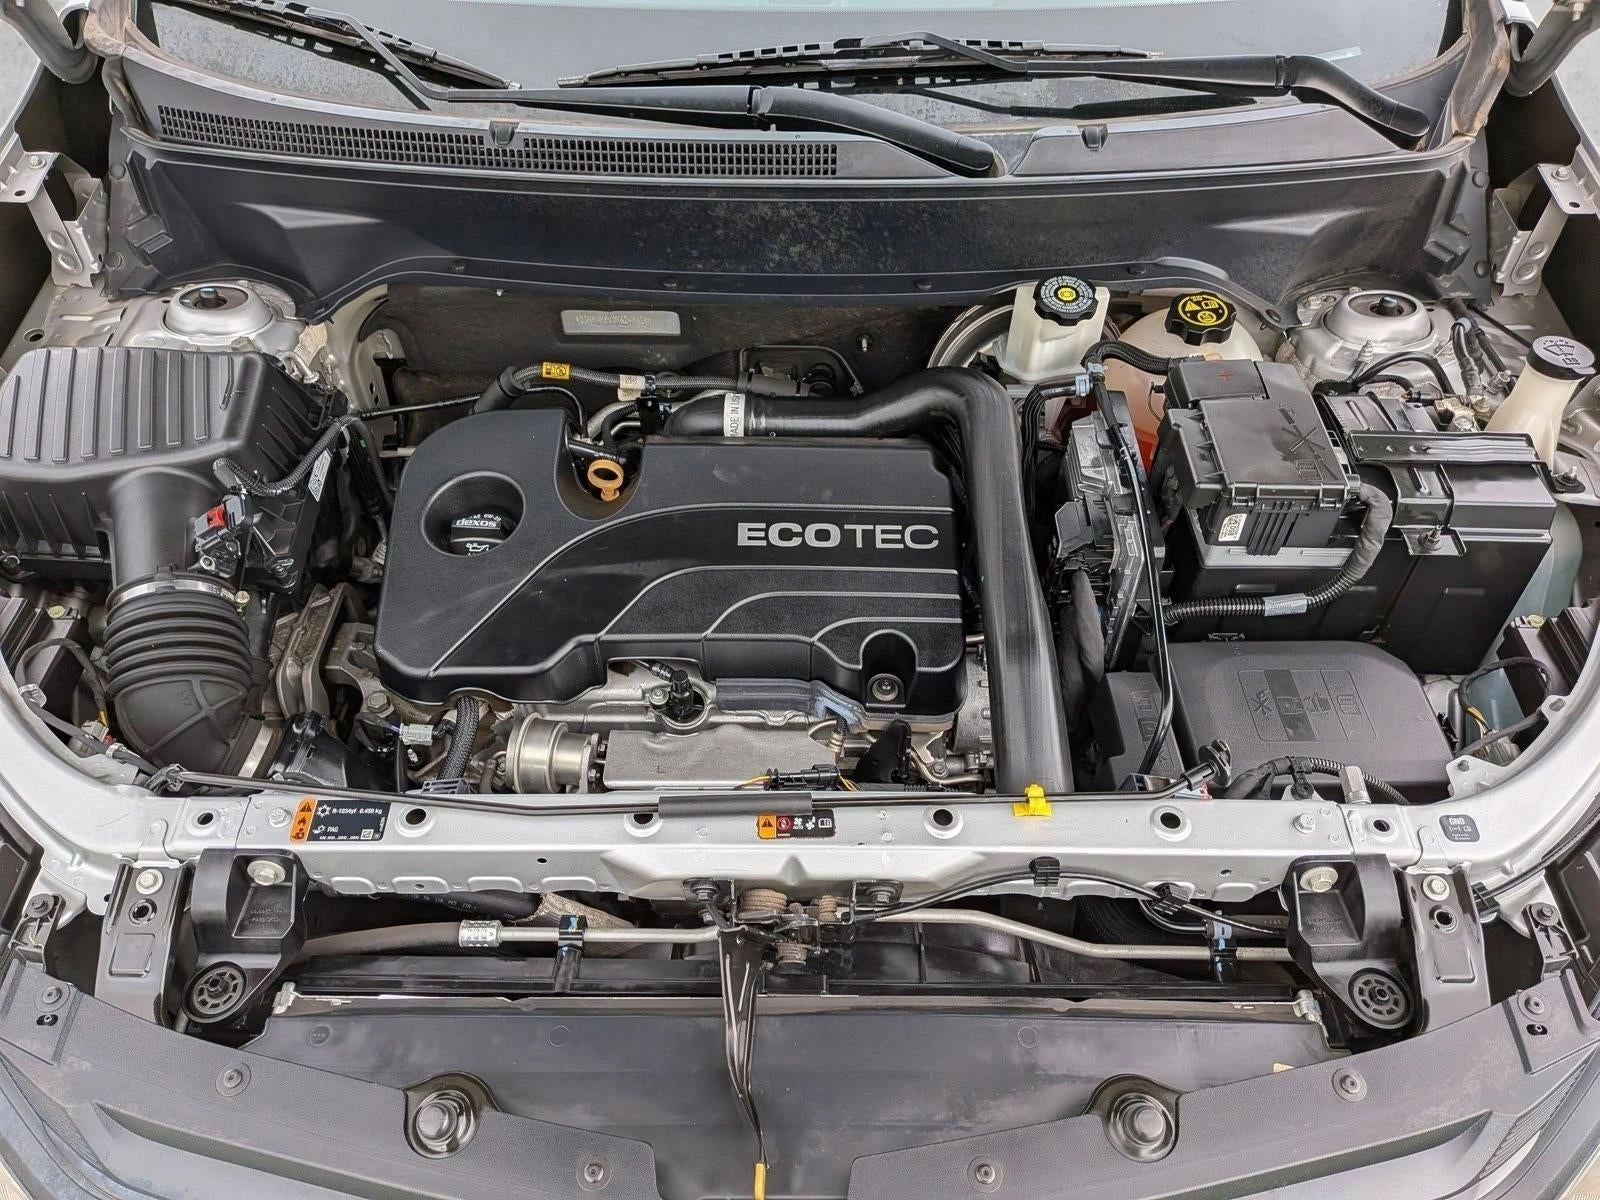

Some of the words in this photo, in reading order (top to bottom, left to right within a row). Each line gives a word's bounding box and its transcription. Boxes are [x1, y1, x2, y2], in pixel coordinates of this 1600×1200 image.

[730, 406, 739, 415] IN
[456, 518, 497, 528] dexos
[737, 522, 940, 550] ECOTEC
[331, 807, 357, 815] R-1234yf
[374, 807, 383, 815] kg
[1449, 817, 1465, 825] GND
